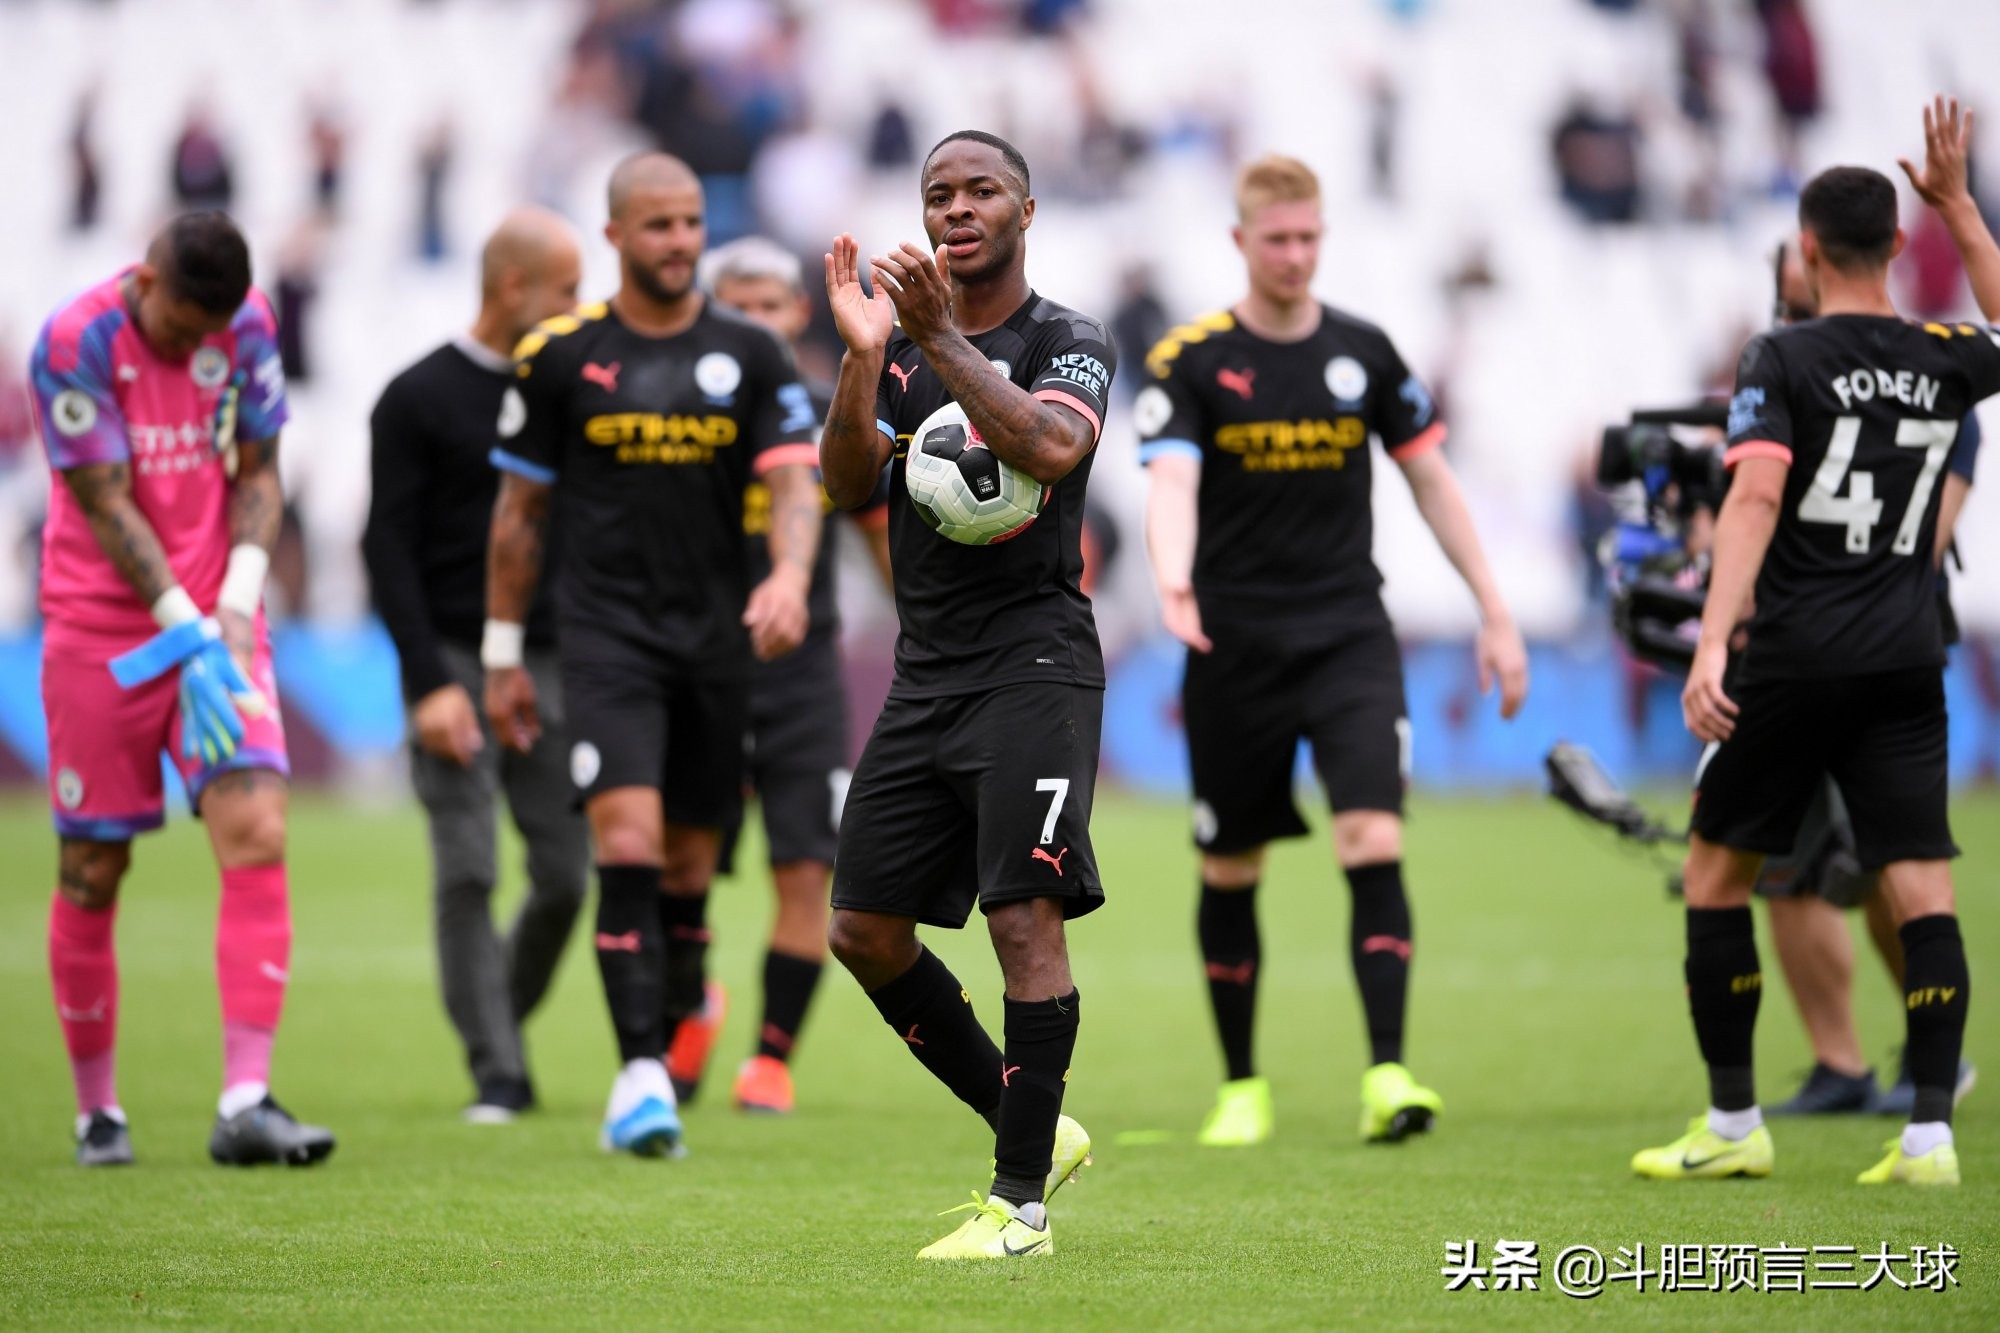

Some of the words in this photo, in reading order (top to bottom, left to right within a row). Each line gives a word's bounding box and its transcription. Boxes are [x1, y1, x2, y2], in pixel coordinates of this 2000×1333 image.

[1051, 353, 1110, 389] NEXEN
[1058, 365, 1102, 397] TIRE
[1831, 368, 1941, 412] FODEN
[584, 412, 738, 447] ETIHAD
[1797, 416, 1959, 556] 47
[1035, 778, 1070, 845] 7
[1906, 986, 1956, 1010] CITY
